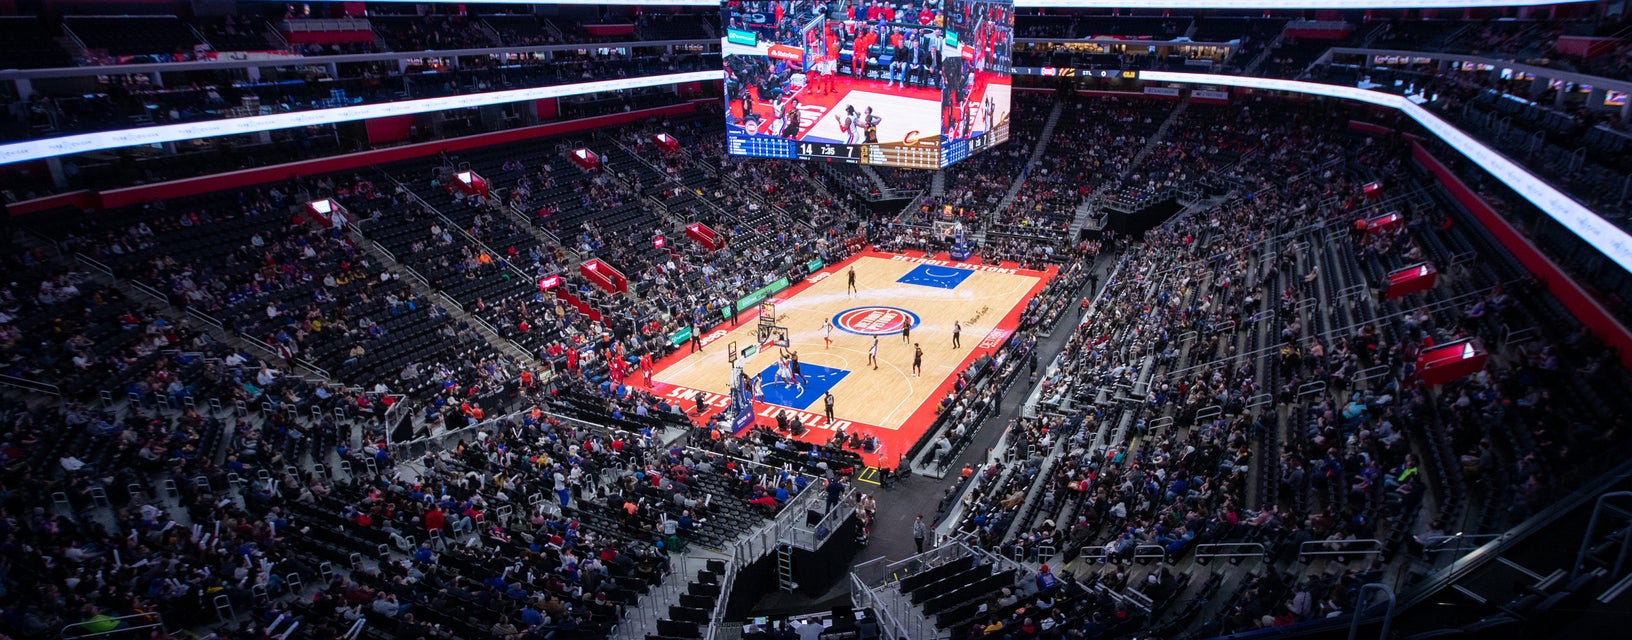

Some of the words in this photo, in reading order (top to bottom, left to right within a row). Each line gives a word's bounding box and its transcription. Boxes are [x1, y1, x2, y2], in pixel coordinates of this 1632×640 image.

[800, 143, 813, 155] 14
[821, 147, 835, 155] 7:35
[847, 147, 854, 158] 7
[892, 255, 951, 266] DETROIT
[955, 262, 1018, 275] PISTONS
